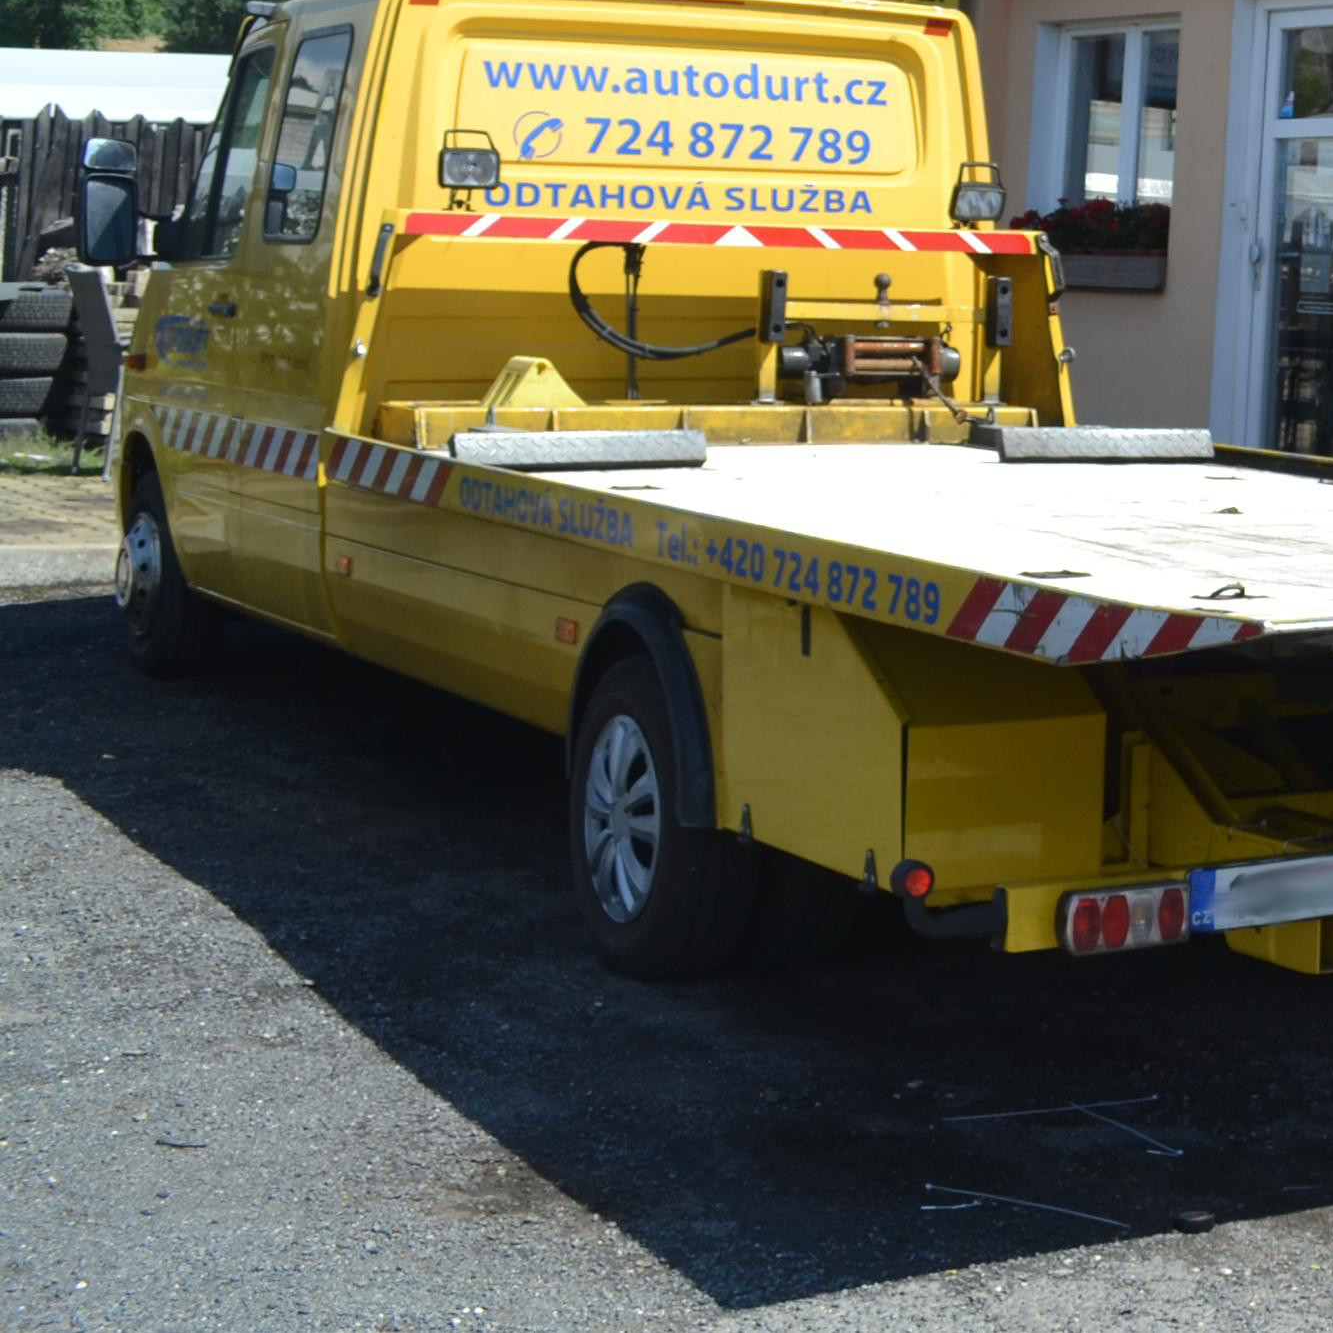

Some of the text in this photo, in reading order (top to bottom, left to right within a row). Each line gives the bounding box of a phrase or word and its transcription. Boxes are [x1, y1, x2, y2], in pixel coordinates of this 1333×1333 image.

[483, 61, 888, 107] www.autodurt.cz
[585, 117, 872, 165] 724 872 789
[484, 181, 873, 214] ODTAHOVÁ SLUŽBA
[460, 475, 941, 625] ODTAHOVÁ SLUŽBA Tel.: +420 724 872 789
[1192, 910, 1211, 926] CZ
